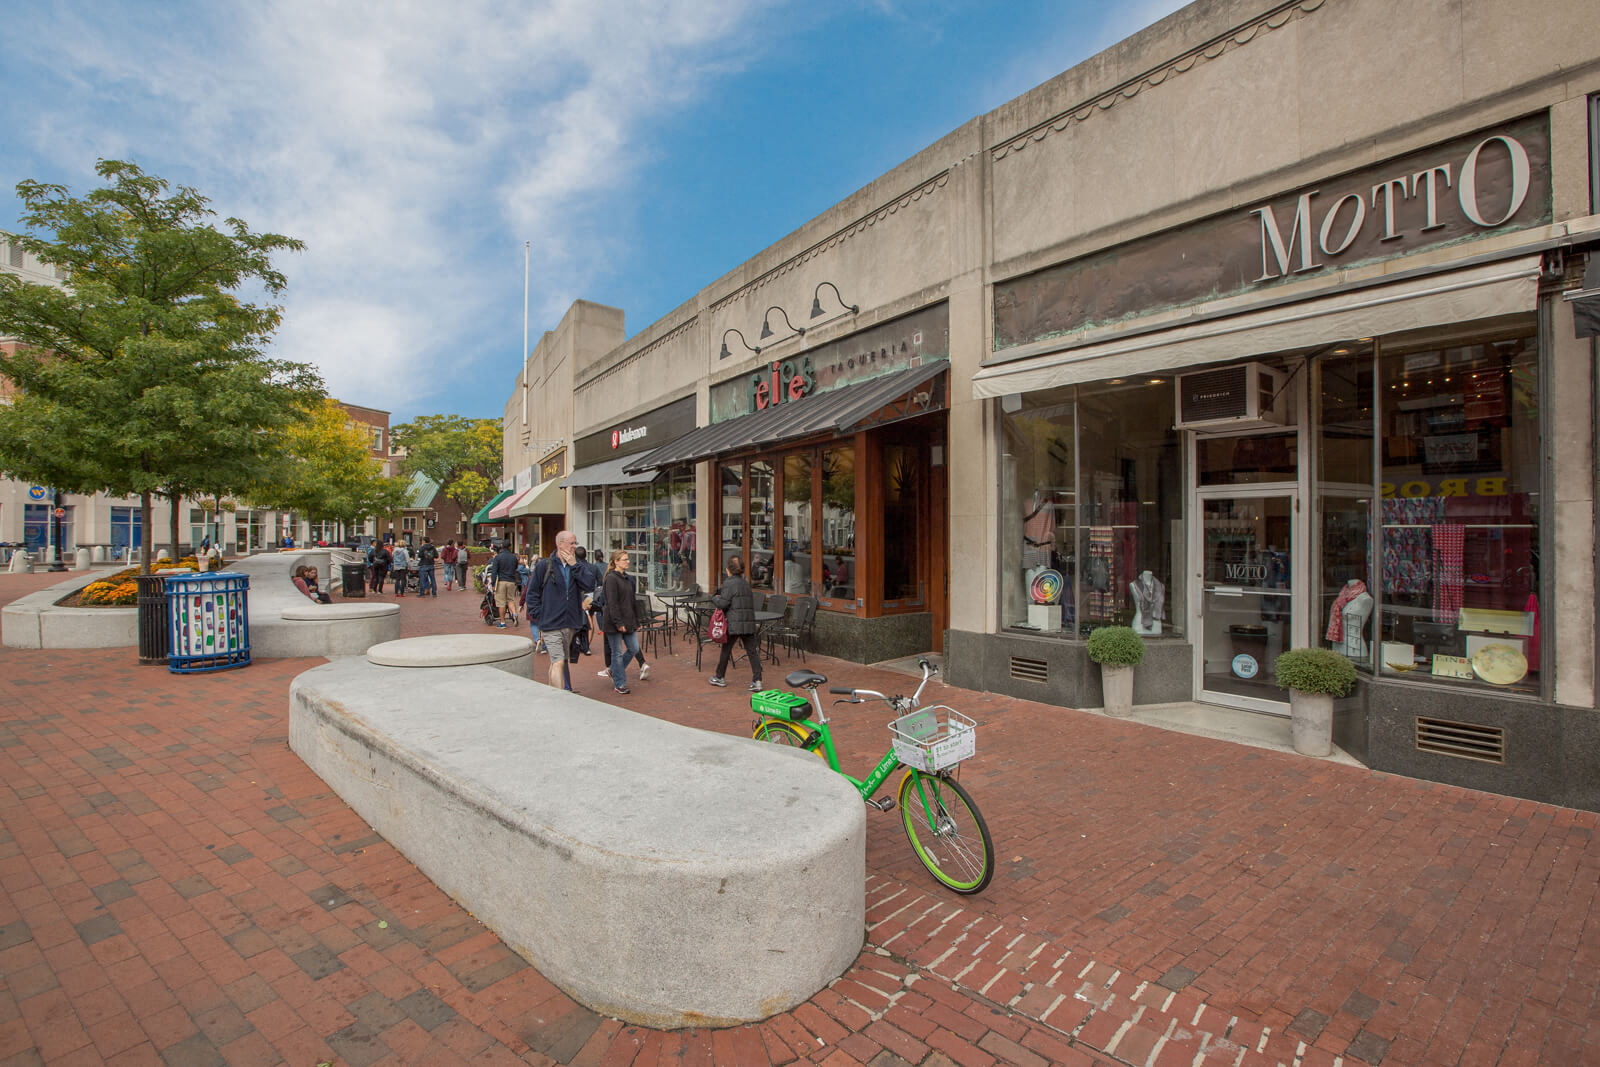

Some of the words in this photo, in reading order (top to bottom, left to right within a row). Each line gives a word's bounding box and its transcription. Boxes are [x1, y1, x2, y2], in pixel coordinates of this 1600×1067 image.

[1250, 135, 1531, 283] MOTTO
[831, 341, 907, 374] TAQUERIA
[1225, 563, 1268, 579] MOTTO
